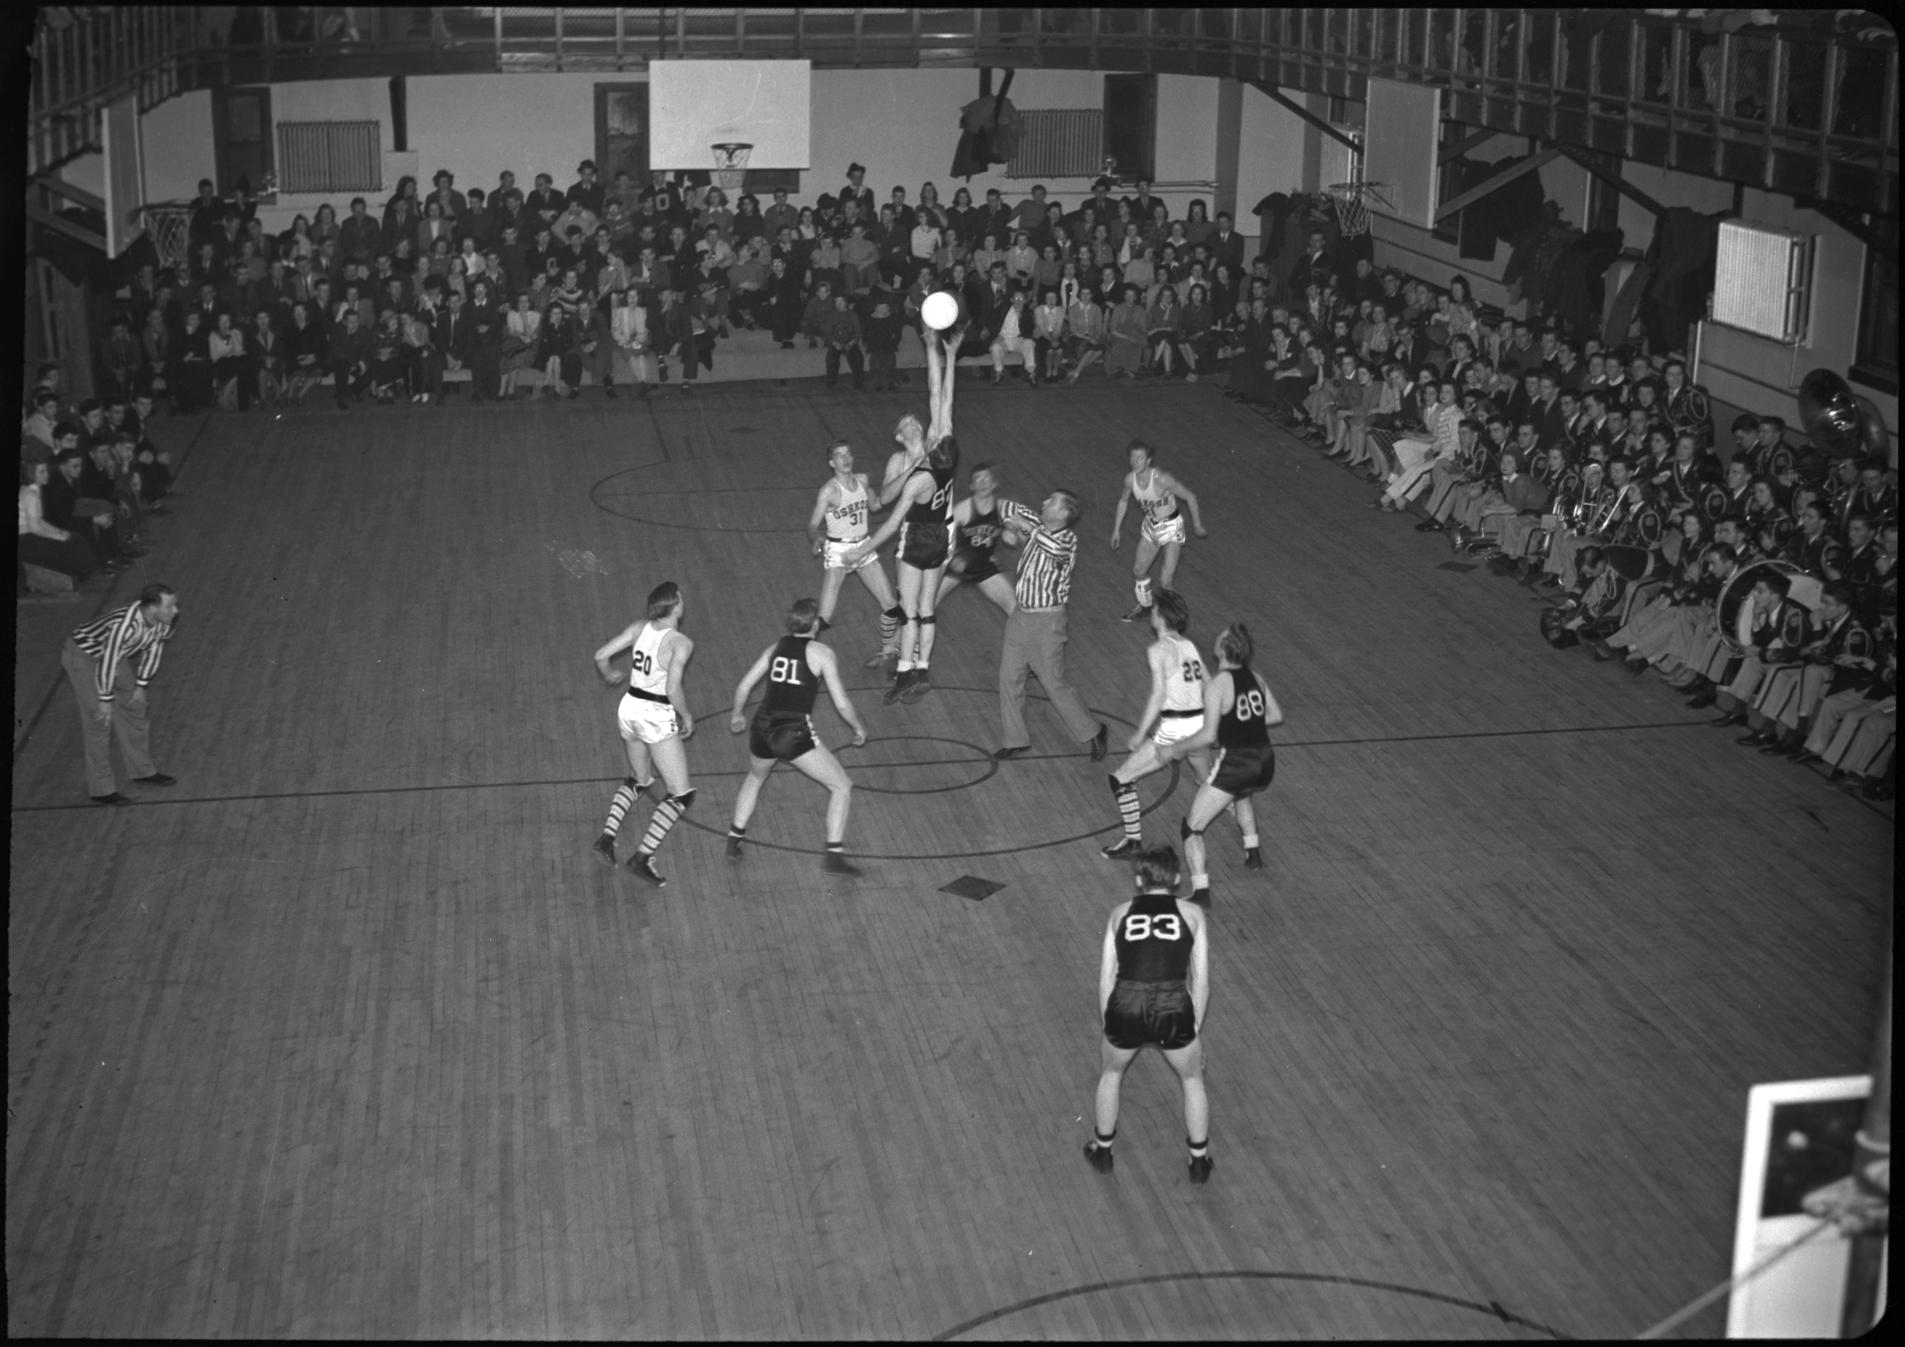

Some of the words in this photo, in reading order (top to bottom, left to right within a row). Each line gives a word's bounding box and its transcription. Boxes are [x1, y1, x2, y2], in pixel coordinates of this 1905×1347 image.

[850, 511, 863, 526] 31
[971, 535, 991, 548] 84
[632, 650, 651, 676] 20
[770, 656, 801, 686] 81
[1183, 660, 1202, 682] 22
[1236, 690, 1264, 721] 88
[1125, 914, 1181, 942] 83
